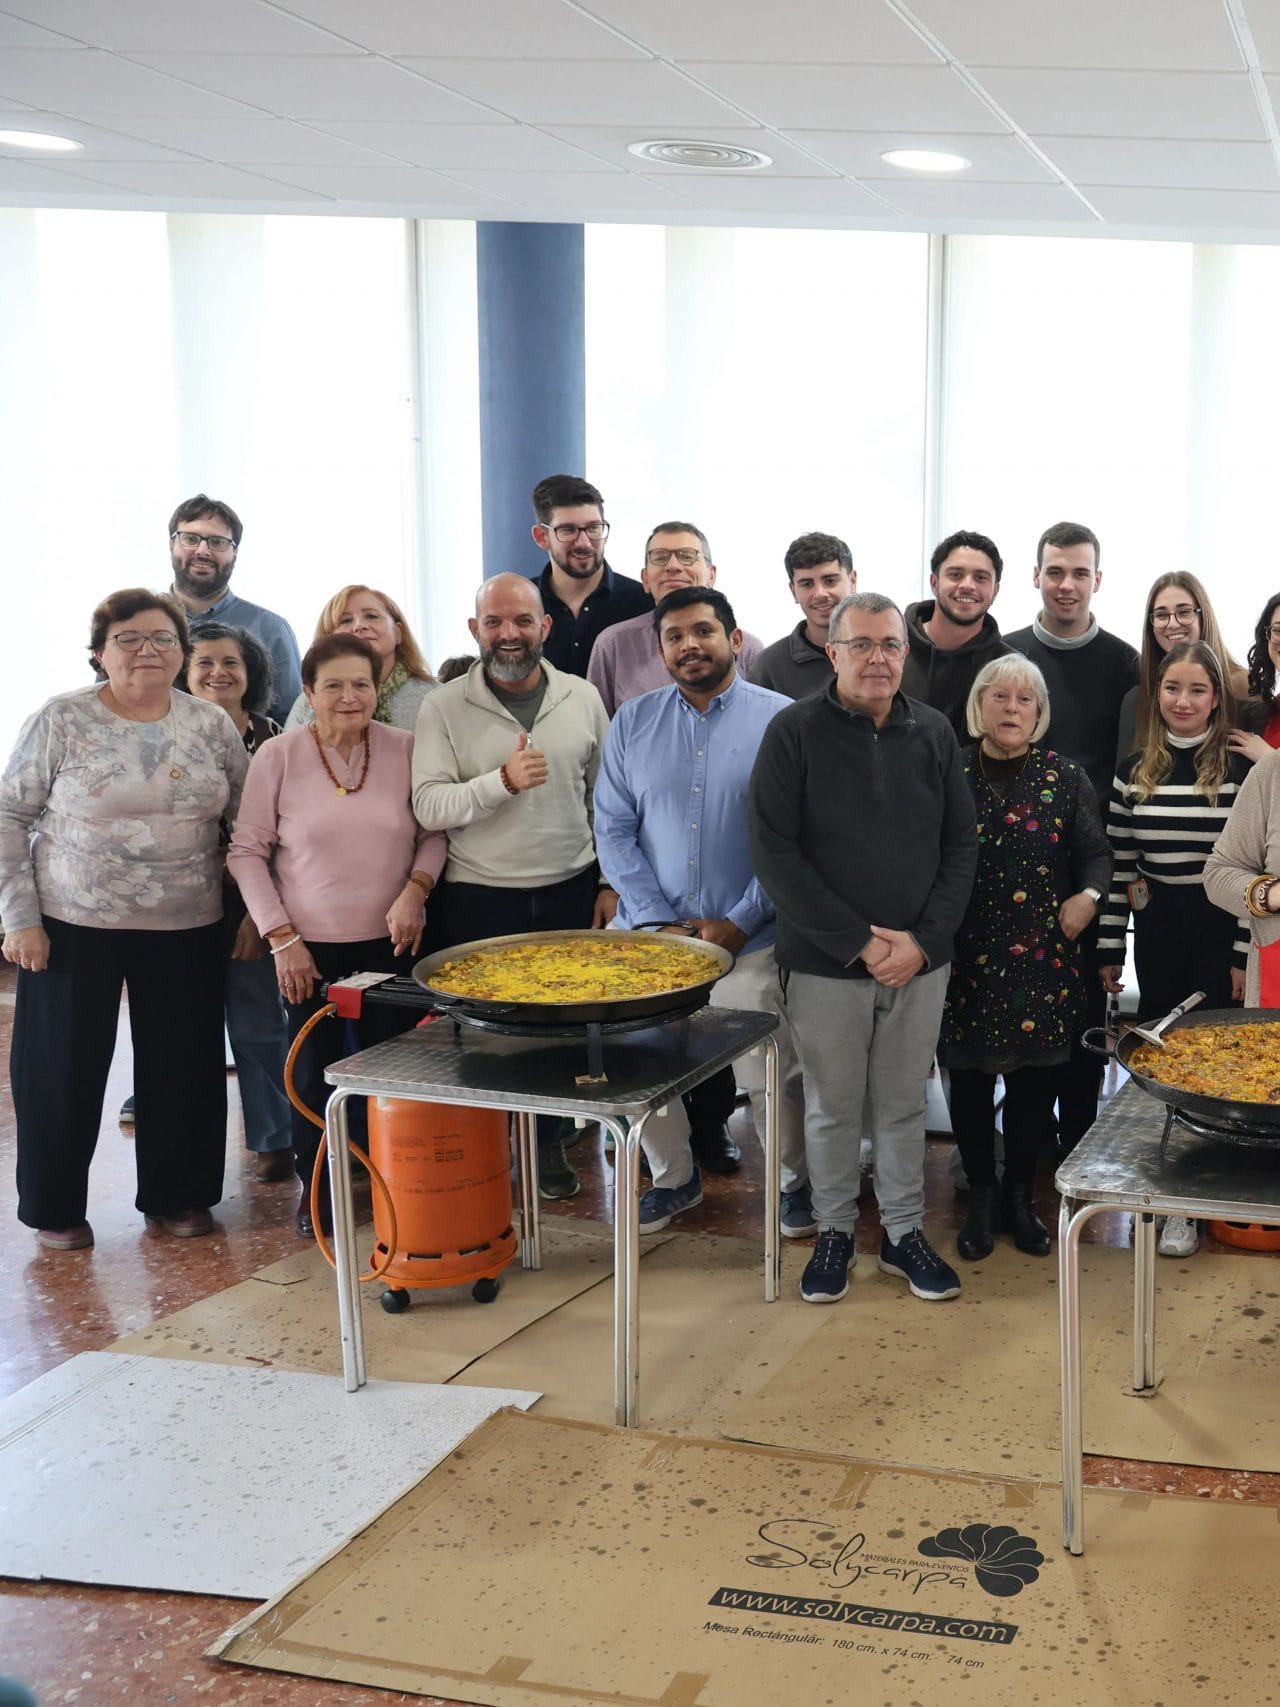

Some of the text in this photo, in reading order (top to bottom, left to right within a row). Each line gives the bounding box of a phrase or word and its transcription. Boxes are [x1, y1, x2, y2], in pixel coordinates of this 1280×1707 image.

[745, 1518, 968, 1594] Solycarpa
[931, 1562, 969, 1573] EVENTOS
[720, 1590, 1008, 1641] www.solycarpa.com
[702, 1621, 739, 1634] Mesa
[832, 1638, 855, 1650] 180
[856, 1644, 878, 1654] cm.
[892, 1647, 907, 1657] 74
[947, 1654, 962, 1665] 74
[965, 1660, 985, 1669] cm
